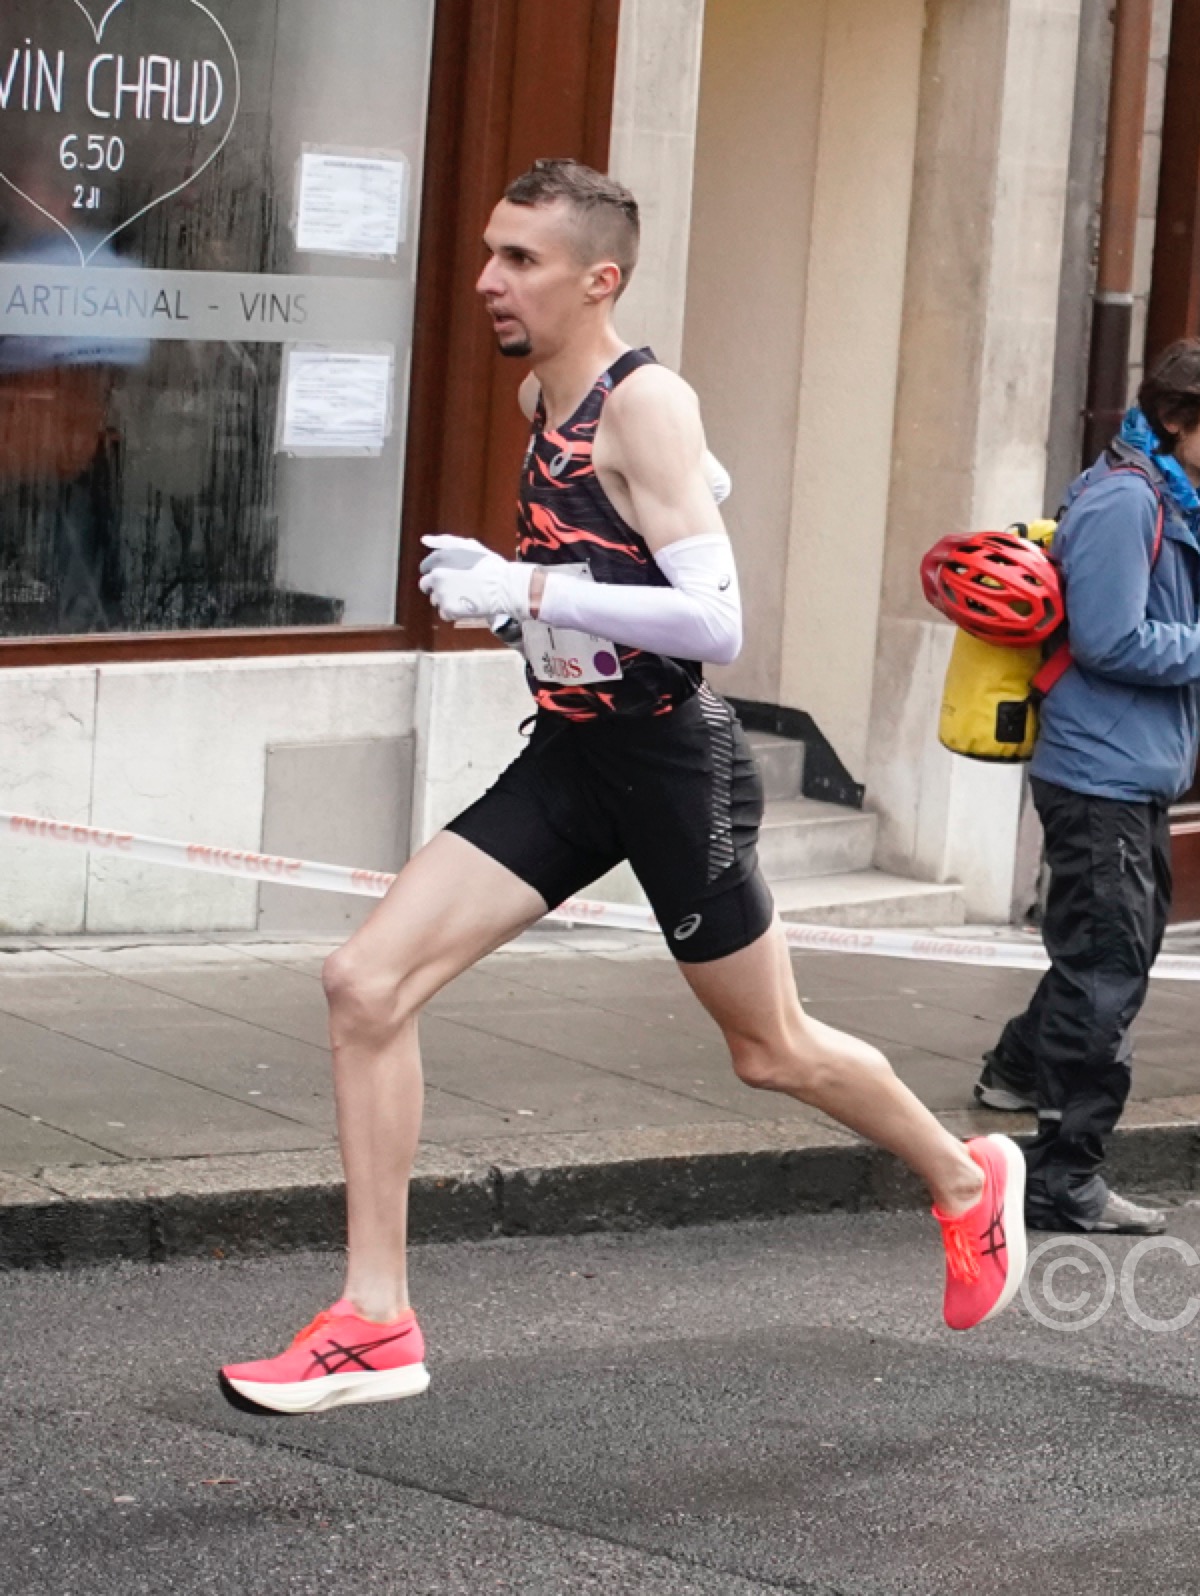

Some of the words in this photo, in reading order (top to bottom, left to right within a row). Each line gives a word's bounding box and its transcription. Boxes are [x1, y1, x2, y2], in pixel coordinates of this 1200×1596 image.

[87, 53, 223, 125] CHAUD
[59, 133, 124, 171] 6.50
[72, 184, 84, 208] 2
[5, 284, 188, 320] ARTISANAL
[240, 291, 307, 324] VINS
